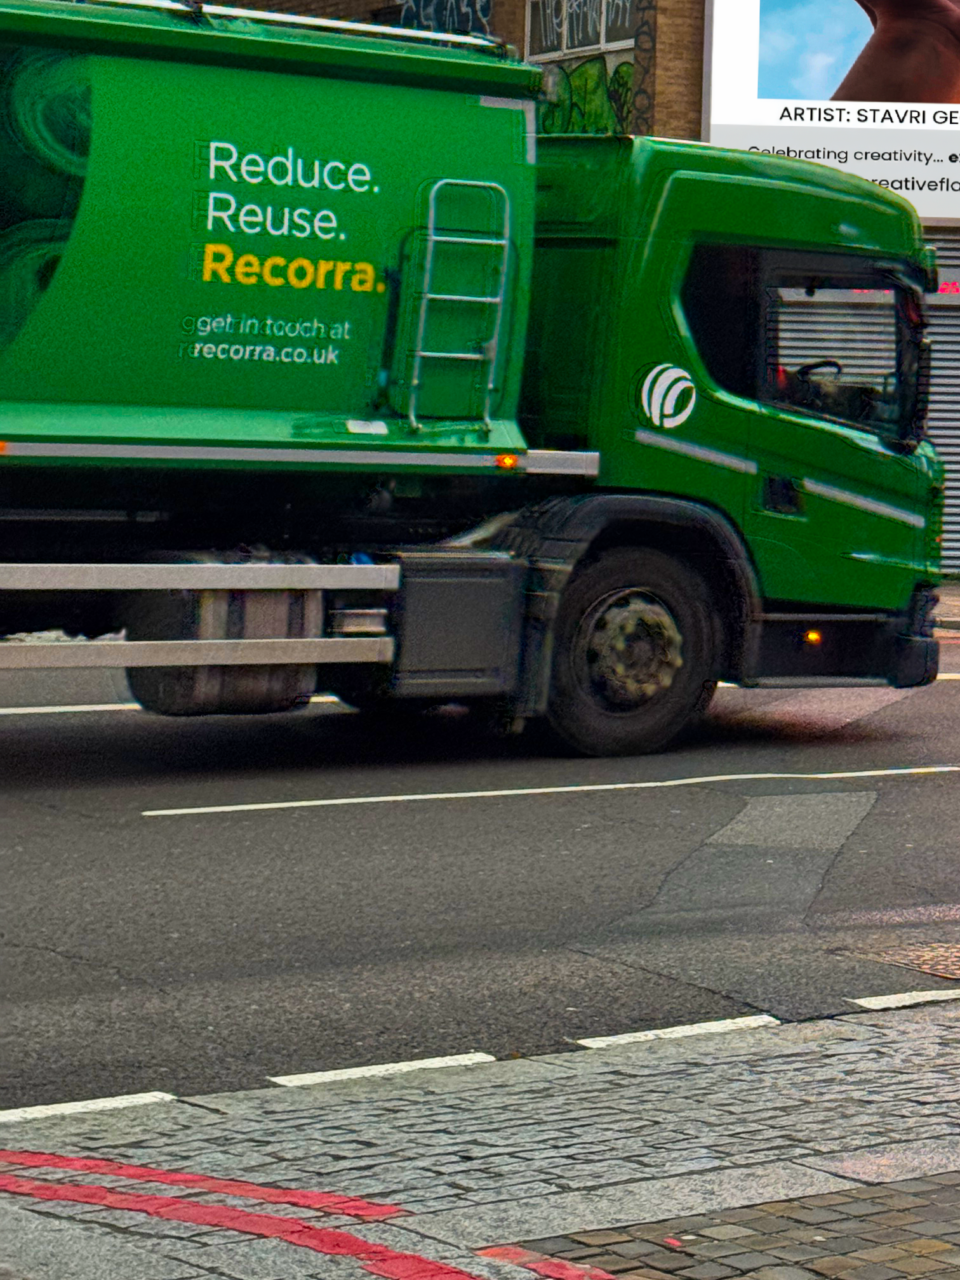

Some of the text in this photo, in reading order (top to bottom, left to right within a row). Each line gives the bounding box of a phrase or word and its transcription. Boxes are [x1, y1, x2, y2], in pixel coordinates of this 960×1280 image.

[779, 106, 851, 123] ARTIST:
[856, 108, 926, 125] STAVRI
[208, 140, 380, 194] Reduce.
[853, 148, 944, 166] creativity...
[207, 191, 346, 241] Reuse.
[202, 242, 386, 294] Recorra.
[329, 320, 351, 340] at
[193, 343, 340, 365] recorra.co.uk
